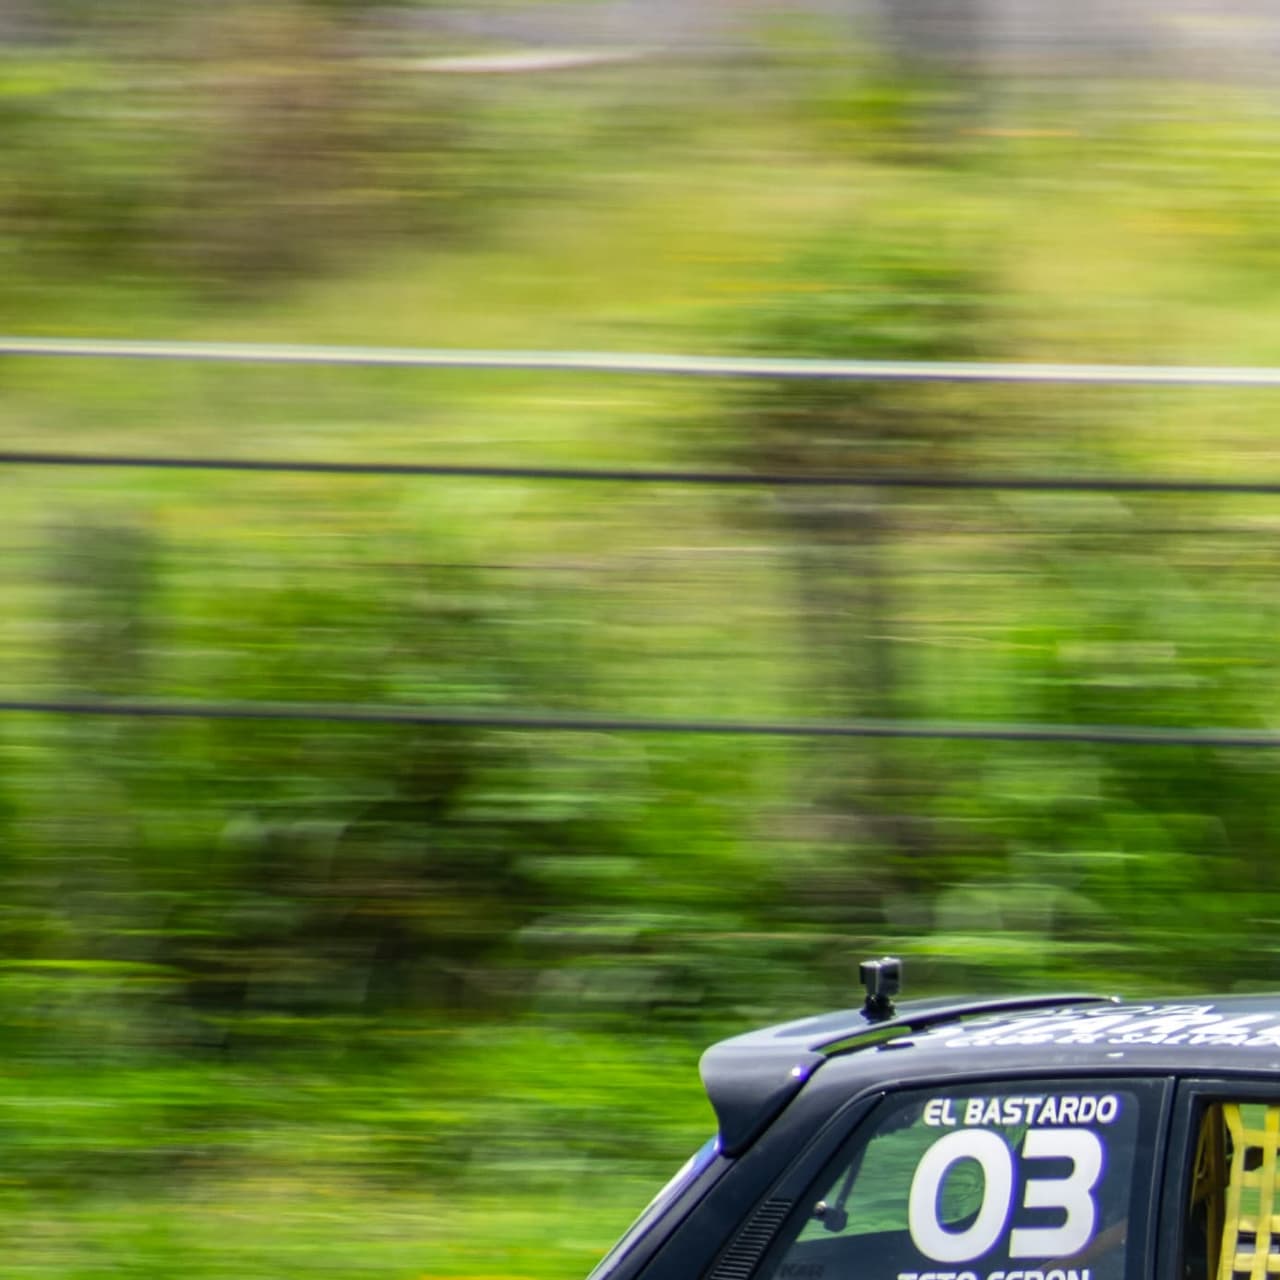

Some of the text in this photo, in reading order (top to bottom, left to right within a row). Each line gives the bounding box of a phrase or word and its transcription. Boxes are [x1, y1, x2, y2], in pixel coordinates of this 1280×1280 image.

[922, 1094, 1119, 1126] EL BASTARDO
[908, 1127, 1102, 1263] 03
